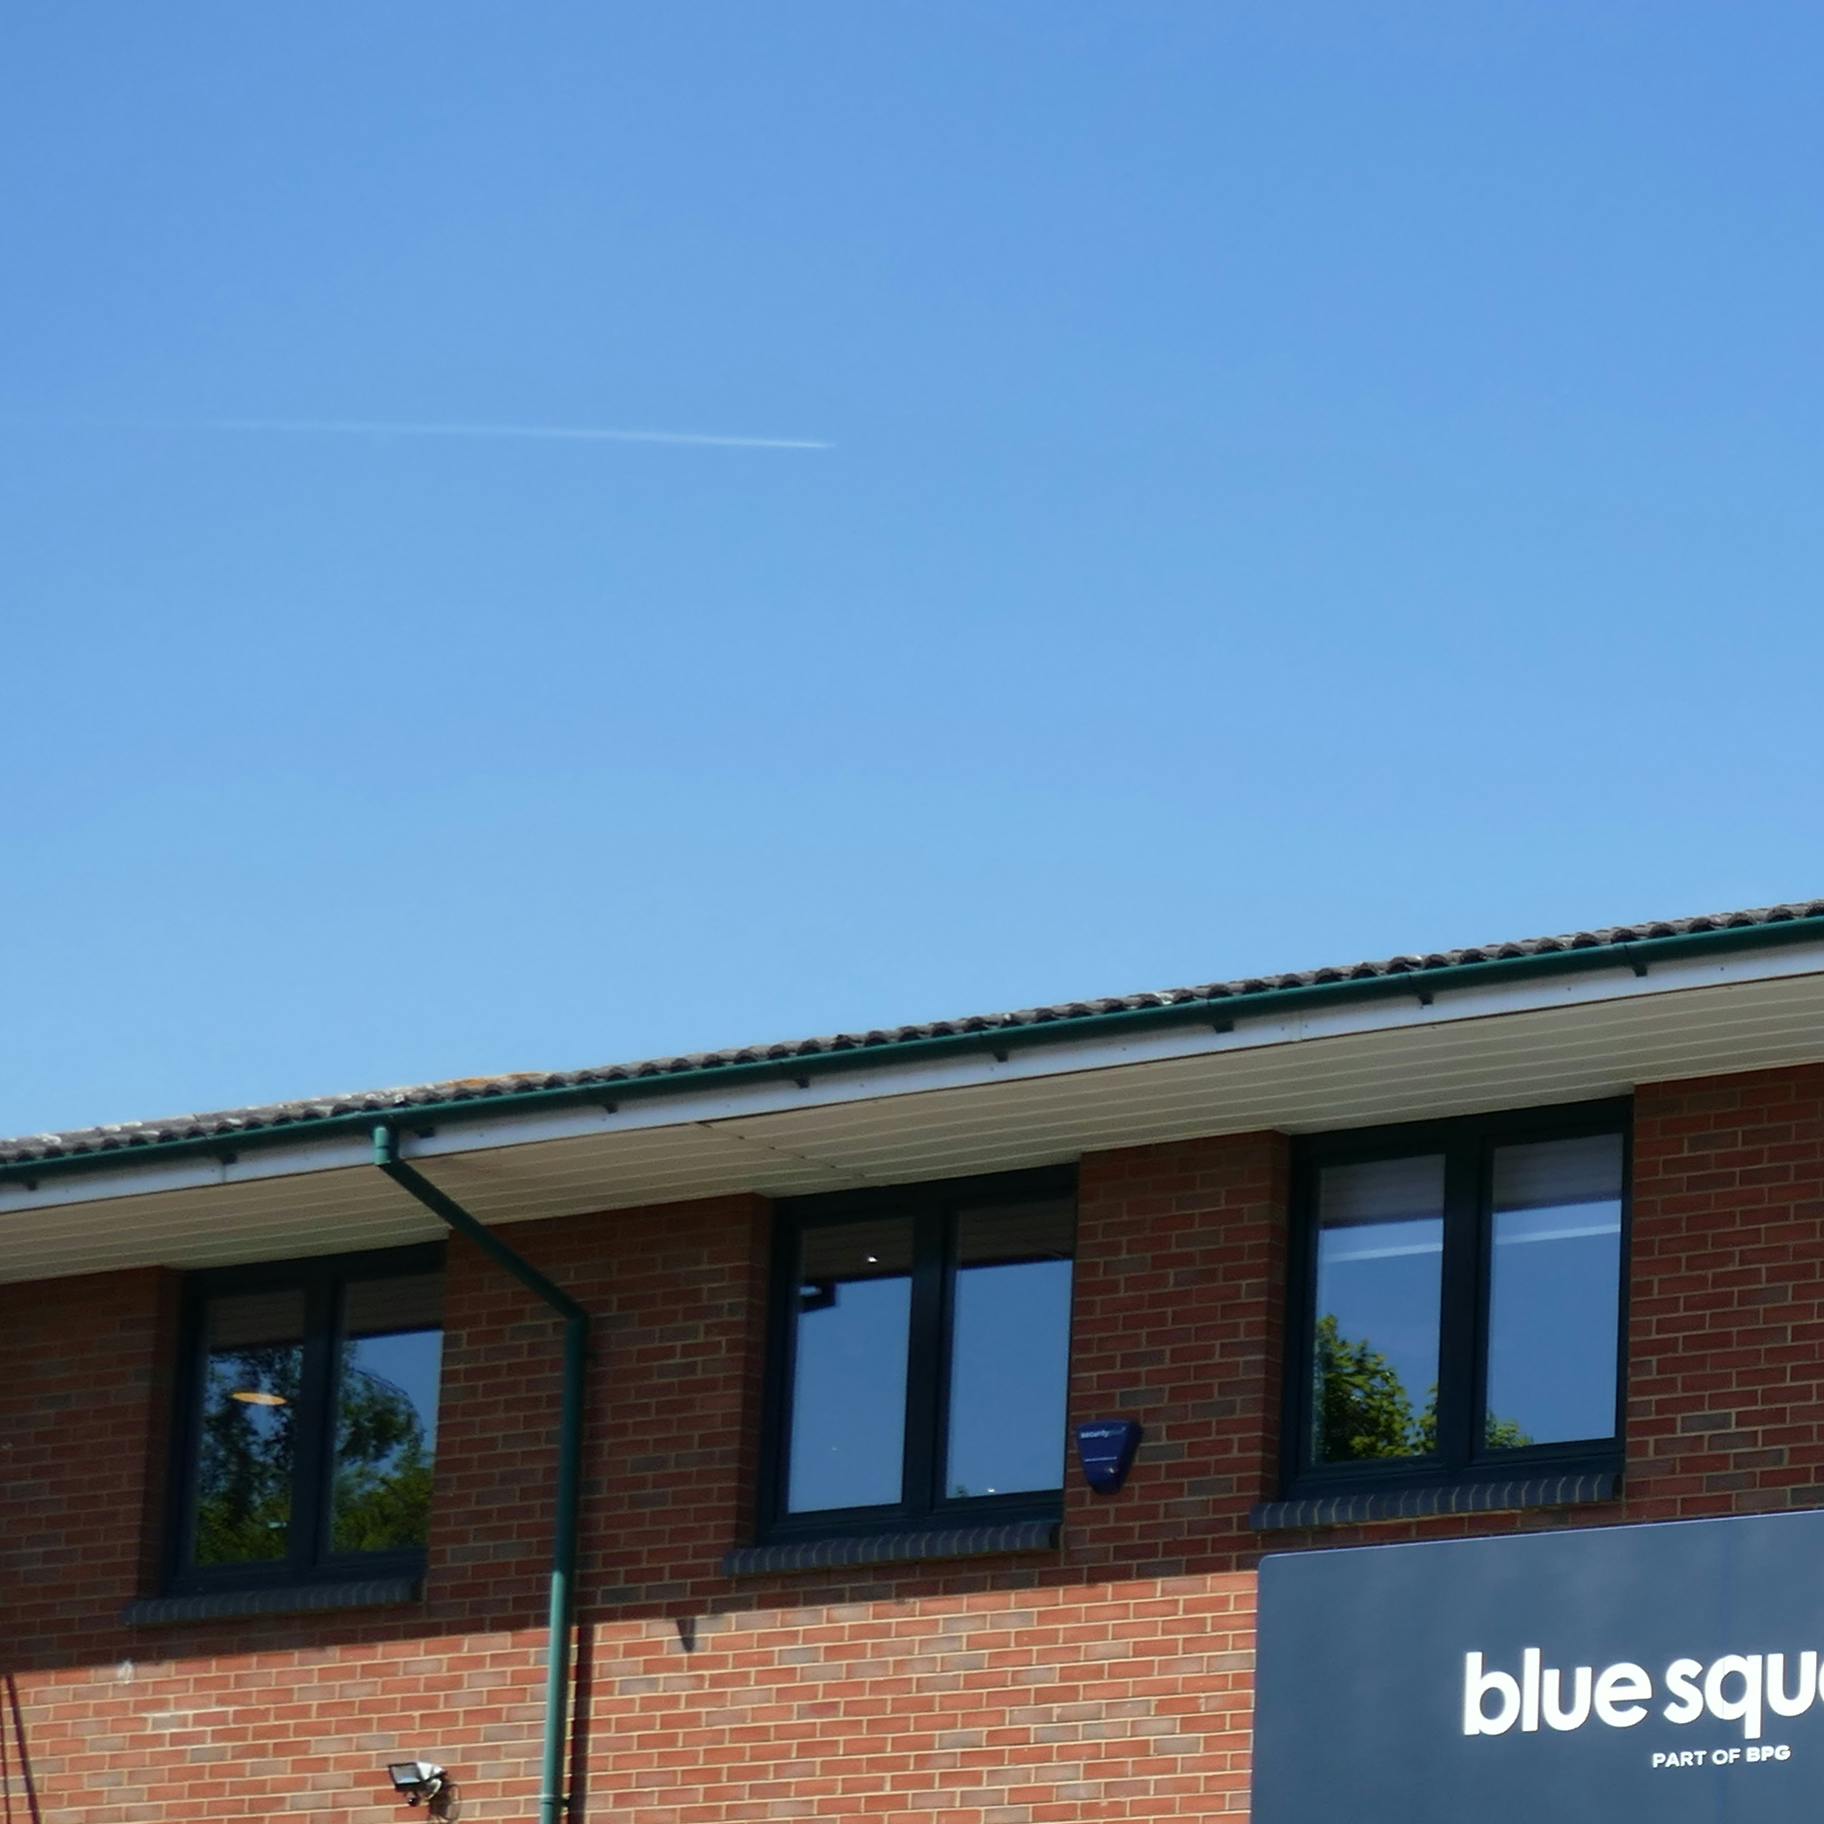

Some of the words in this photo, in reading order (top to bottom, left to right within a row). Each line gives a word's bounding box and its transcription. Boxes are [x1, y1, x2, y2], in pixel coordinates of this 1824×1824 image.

[1464, 1647, 1652, 1736] blue
[1652, 1750, 1707, 1768] PART
[1711, 1748, 1741, 1765] OF
[1746, 1744, 1791, 1762] BPG
